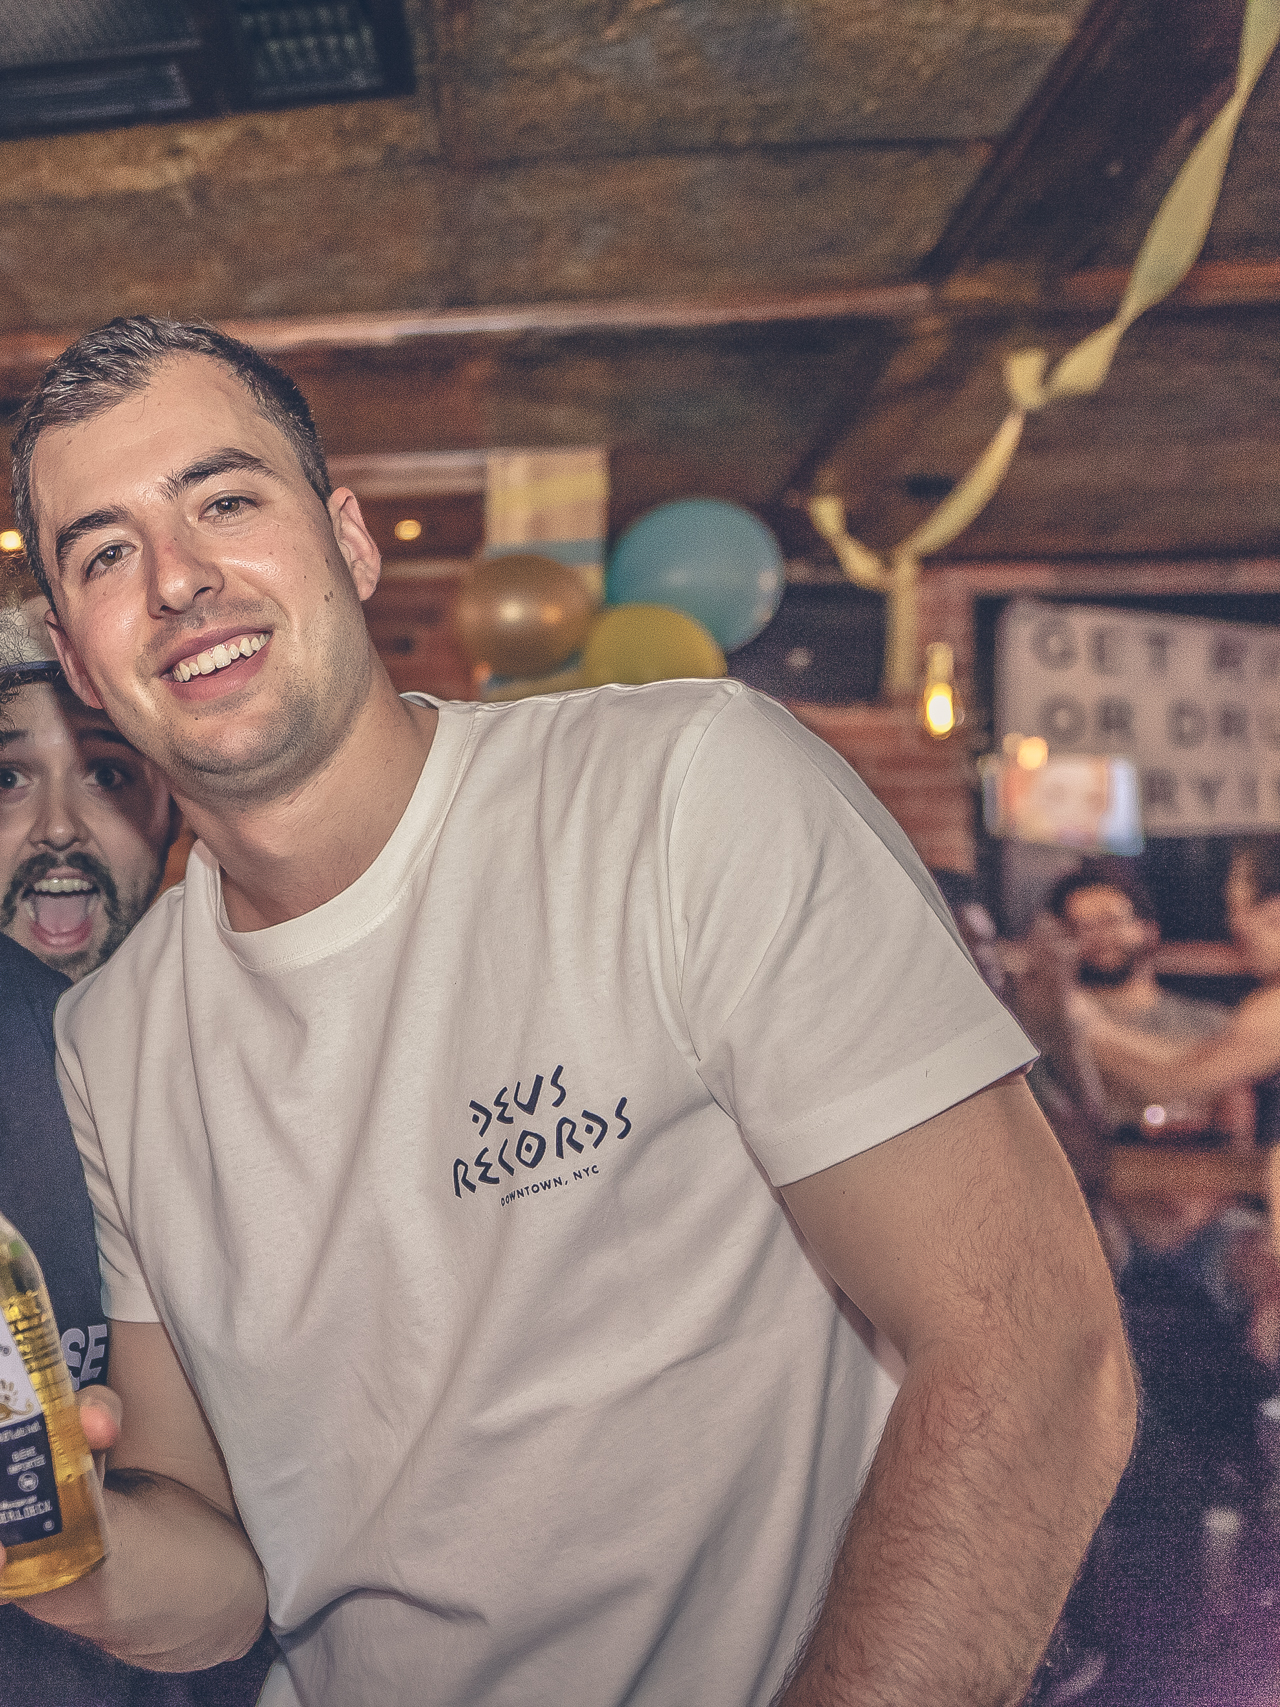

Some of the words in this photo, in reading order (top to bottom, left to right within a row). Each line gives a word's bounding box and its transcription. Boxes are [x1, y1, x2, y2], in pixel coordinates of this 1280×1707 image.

[1030, 617, 1173, 680] GET
[1038, 695, 1136, 745] OR
[469, 1065, 566, 1137] DEUS
[453, 1097, 632, 1198] RECORDS
[500, 1176, 569, 1207] DOWNTOWN,
[572, 1164, 600, 1181] NYC
